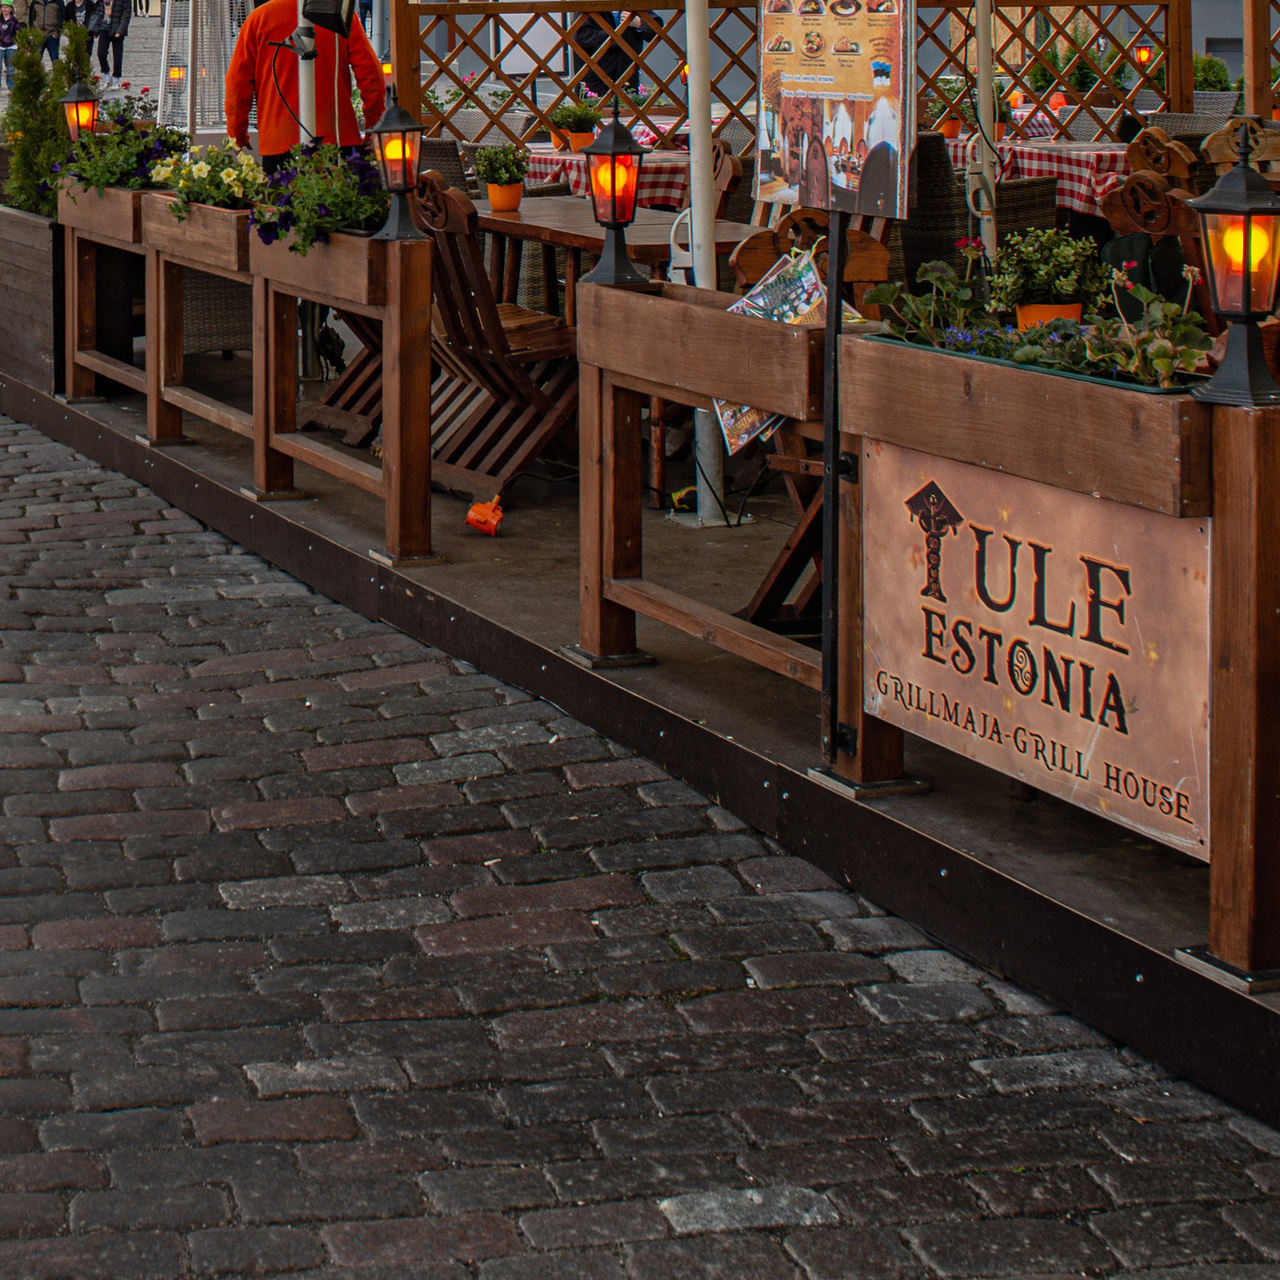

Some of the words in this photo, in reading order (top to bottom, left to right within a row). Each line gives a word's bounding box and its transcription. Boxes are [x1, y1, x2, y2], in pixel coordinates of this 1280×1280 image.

[904, 480, 1133, 656] TULE
[921, 606, 1129, 735] ESTONIA
[1103, 762, 1195, 825] HOUSE
